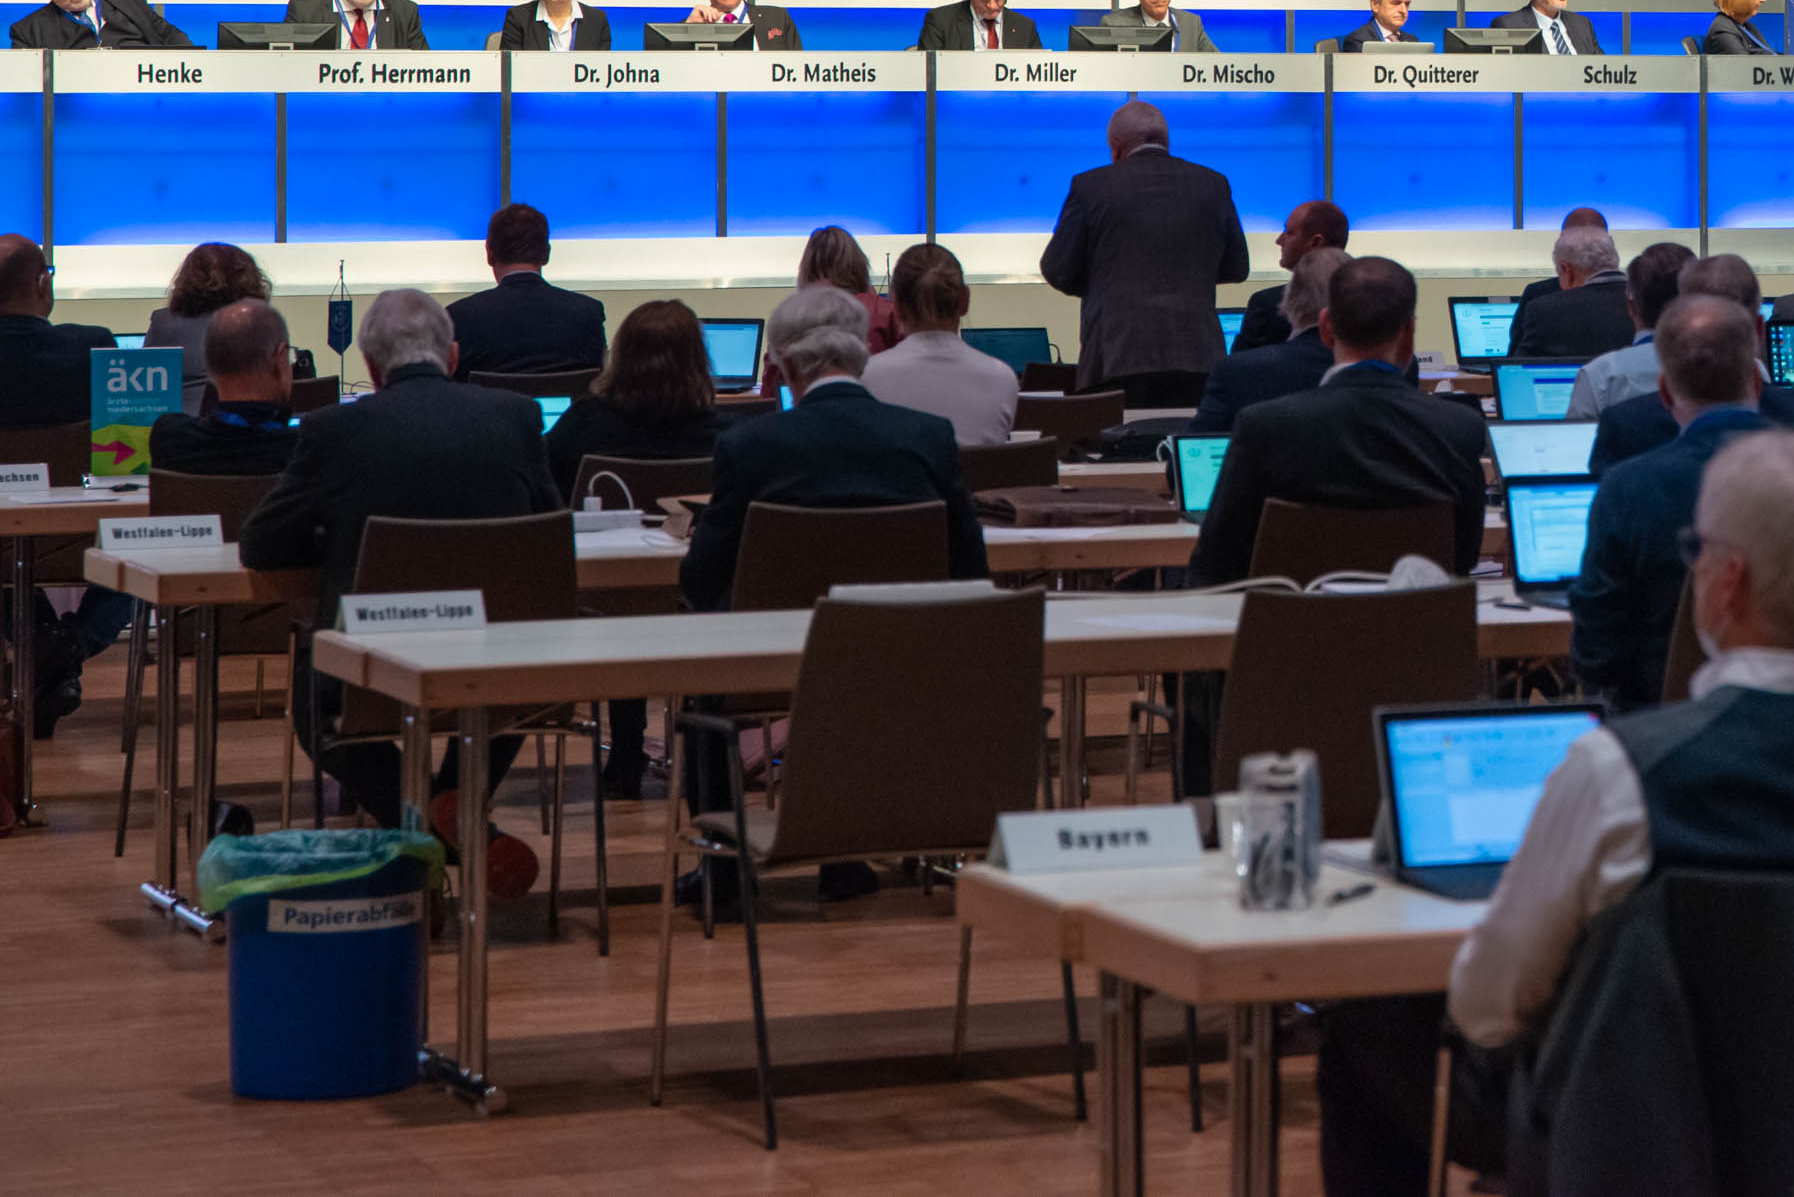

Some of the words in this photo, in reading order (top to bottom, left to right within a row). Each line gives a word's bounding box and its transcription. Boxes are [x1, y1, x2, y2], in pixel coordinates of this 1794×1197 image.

[138, 62, 203, 83] Henke
[319, 62, 364, 83] Prof.
[372, 64, 470, 83] Herrmann
[574, 63, 600, 83] Dr.
[606, 62, 660, 88] Johna
[771, 63, 797, 82] Dr.
[804, 62, 876, 82] Matheis
[995, 63, 1019, 82] Dr.
[1026, 62, 1077, 82] Miller
[1183, 64, 1206, 83] Dr.
[1213, 63, 1275, 83] Mischo
[1374, 65, 1397, 84] Dr.
[1402, 64, 1479, 88] Quitterer
[1583, 64, 1637, 84] Schulz
[1753, 67, 1775, 85] Dr.
[112, 524, 213, 540] Westfalen-Lippe
[355, 603, 474, 622] Westfalen-Lippe
[1057, 827, 1152, 852] Bayern
